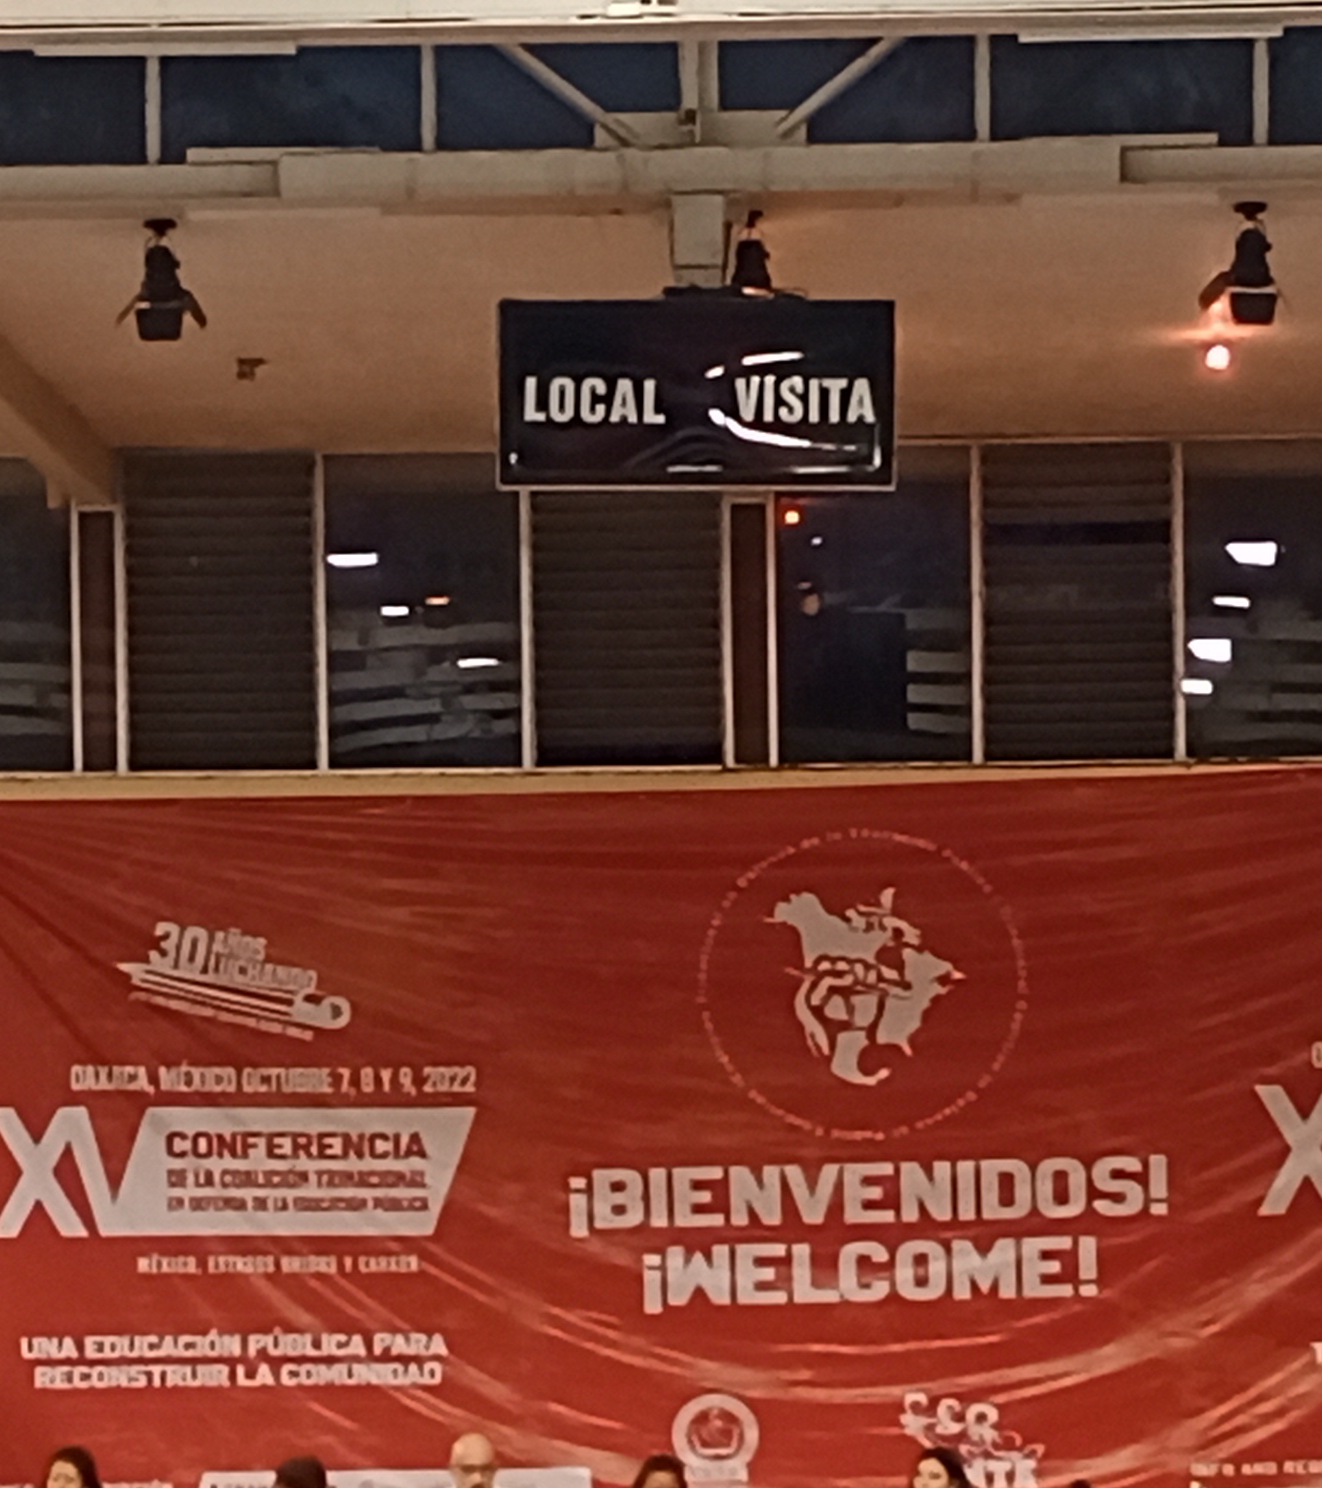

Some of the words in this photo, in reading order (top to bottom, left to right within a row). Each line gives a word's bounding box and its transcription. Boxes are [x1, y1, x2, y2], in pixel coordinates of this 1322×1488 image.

[523, 375, 666, 424] LOCAL
[734, 374, 876, 424] VISITA
[148, 921, 209, 976] 30
[241, 1066, 334, 1093] OCTUBRE
[378, 1067, 393, 1093] Y
[422, 1066, 476, 1093] 2022
[165, 1131, 429, 1160] CONFERENCIA
[194, 1168, 215, 1188] LA
[569, 1154, 1168, 1238] ¡BIENVENIDOS!
[643, 1235, 1098, 1314] ¡WELCOME!
[20, 1336, 78, 1360] UNA
[83, 1328, 242, 1360] EDUCACIÓN
[247, 1326, 367, 1359] PÚBLICA
[372, 1332, 449, 1358] PARA
[33, 1363, 231, 1390] RECONSTRUIR
[235, 1363, 276, 1388] LA
[279, 1361, 444, 1387] COMUNIDAD
